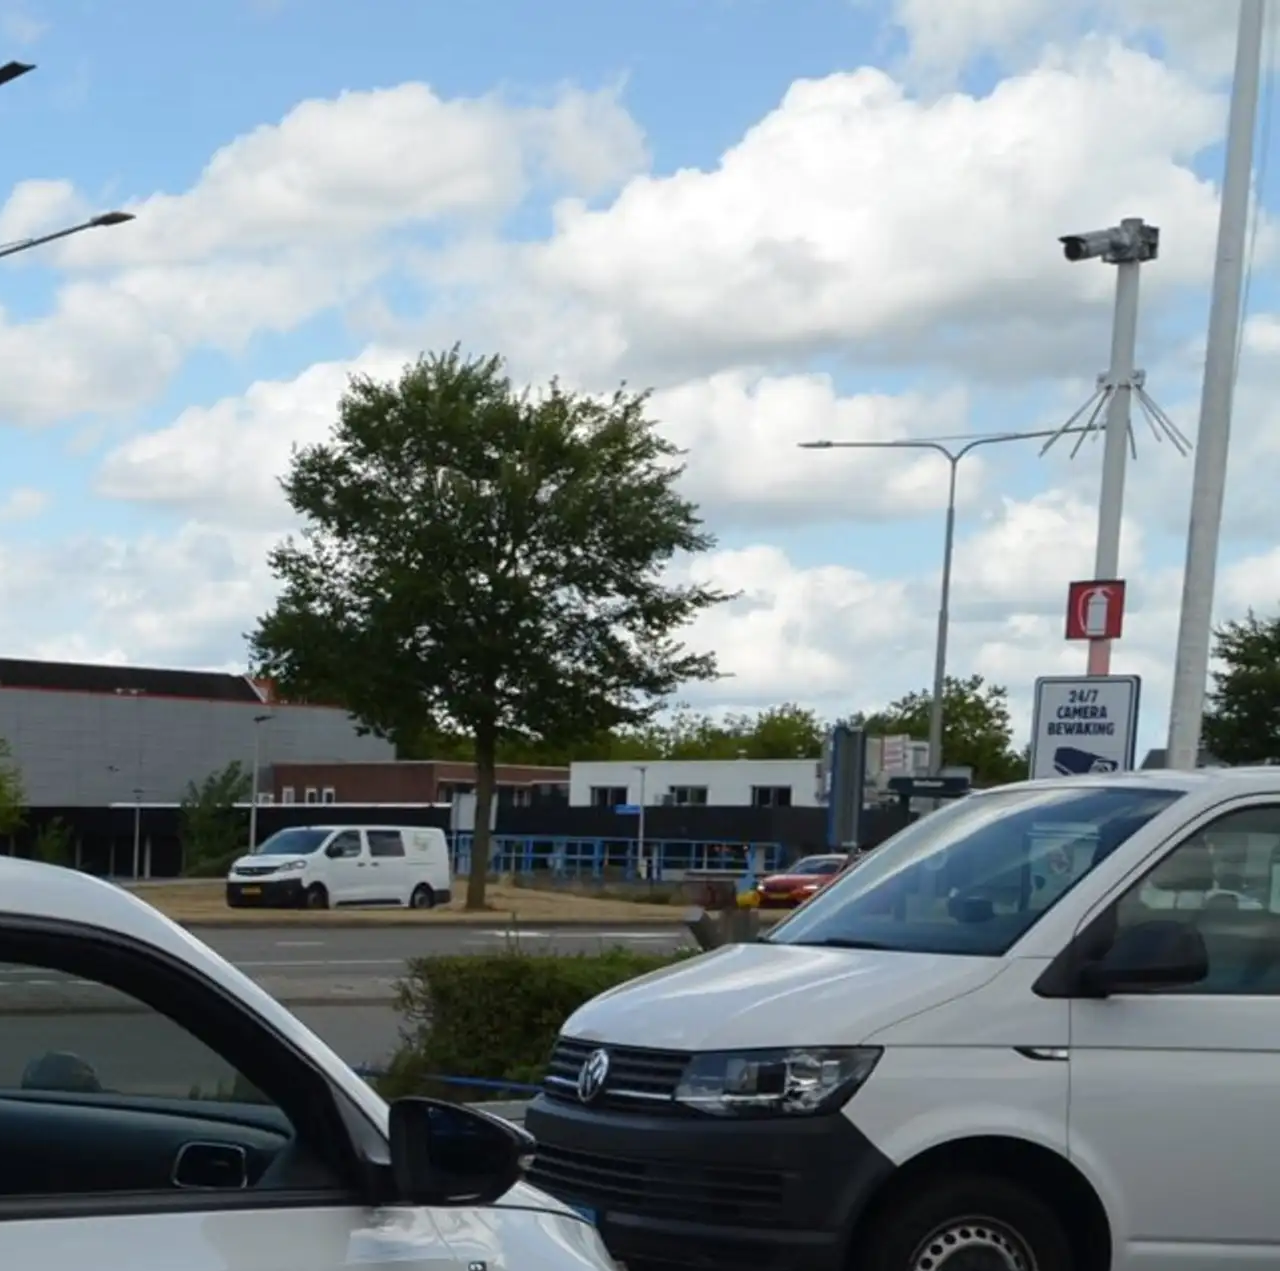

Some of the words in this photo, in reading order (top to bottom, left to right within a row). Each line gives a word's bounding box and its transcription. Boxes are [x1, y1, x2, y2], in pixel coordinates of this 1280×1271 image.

[1069, 690, 1098, 703] 24/7
[1057, 706, 1107, 719] CAMERA
[1048, 722, 1114, 736] BEWAKING
